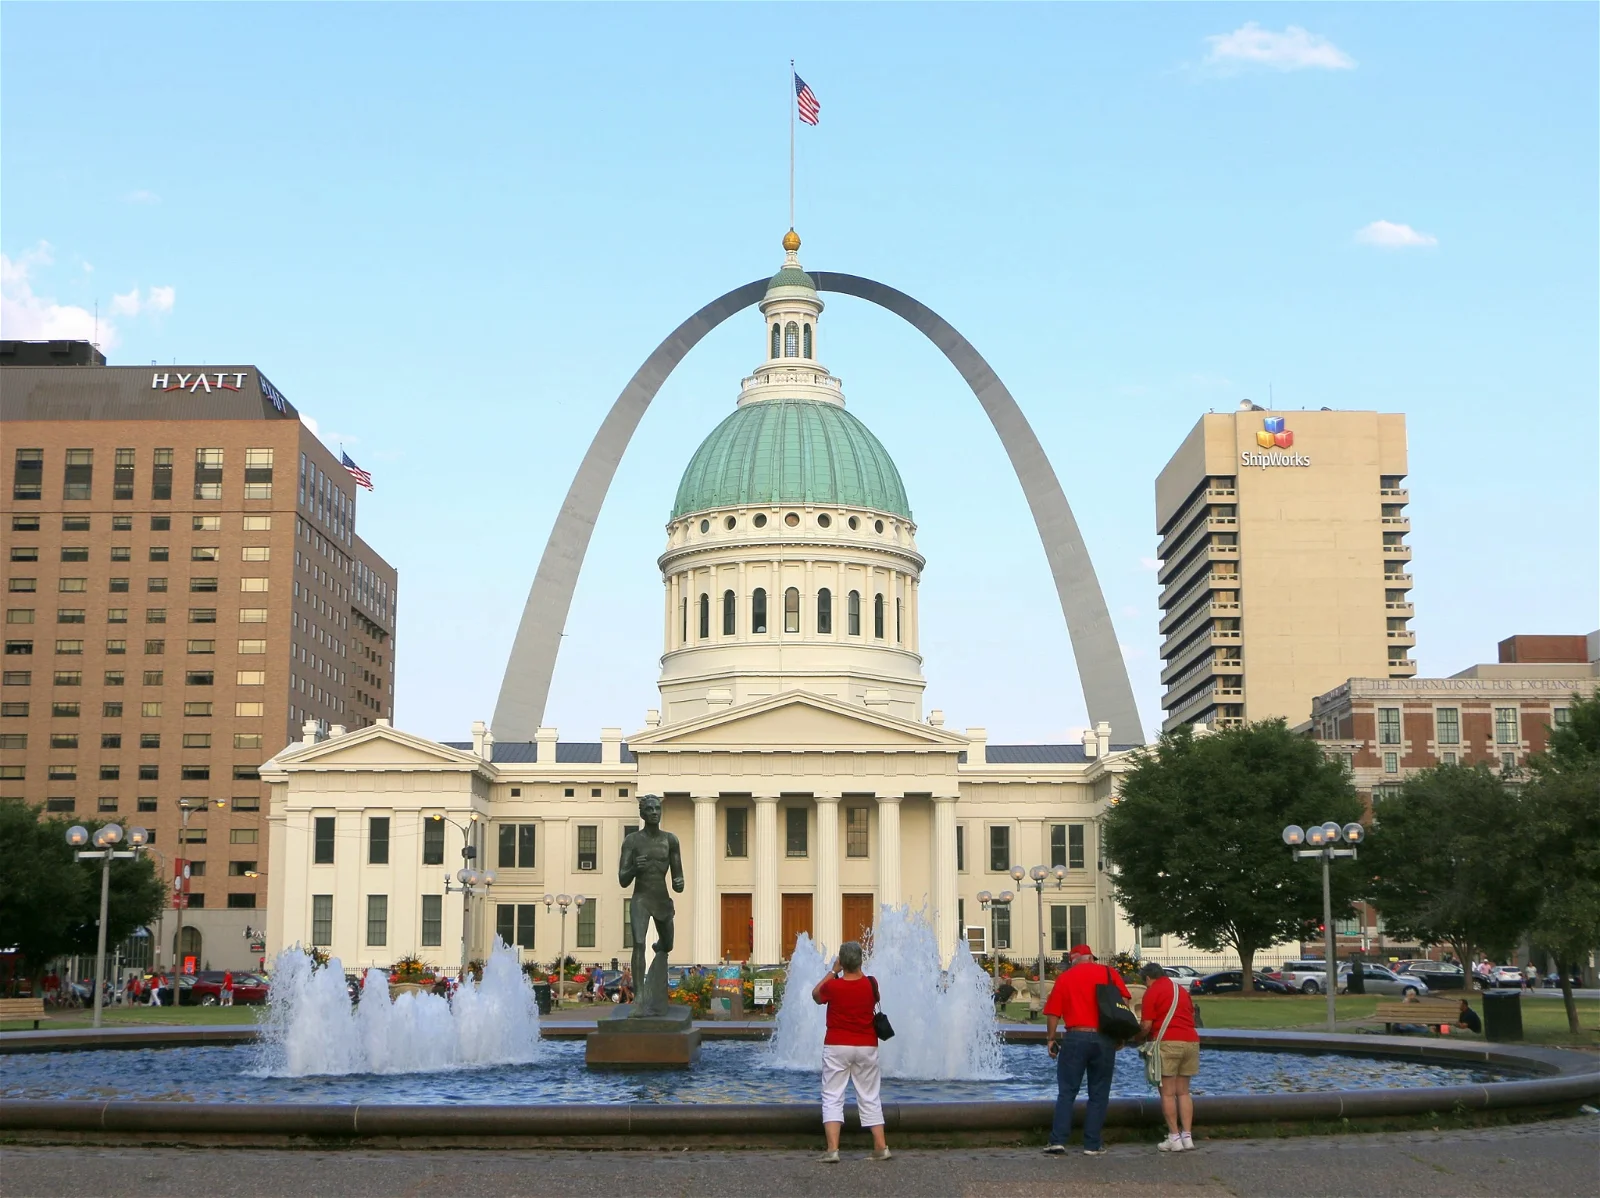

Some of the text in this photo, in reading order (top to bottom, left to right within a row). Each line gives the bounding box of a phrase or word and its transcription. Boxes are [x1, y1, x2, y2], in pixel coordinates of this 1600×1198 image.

[151, 373, 248, 393] HYATT
[259, 375, 287, 414] HYATT
[1241, 451, 1311, 469] ShipWorks
[1371, 680, 1581, 690] THE INTERNATIONAL FUR EXCHANGE
